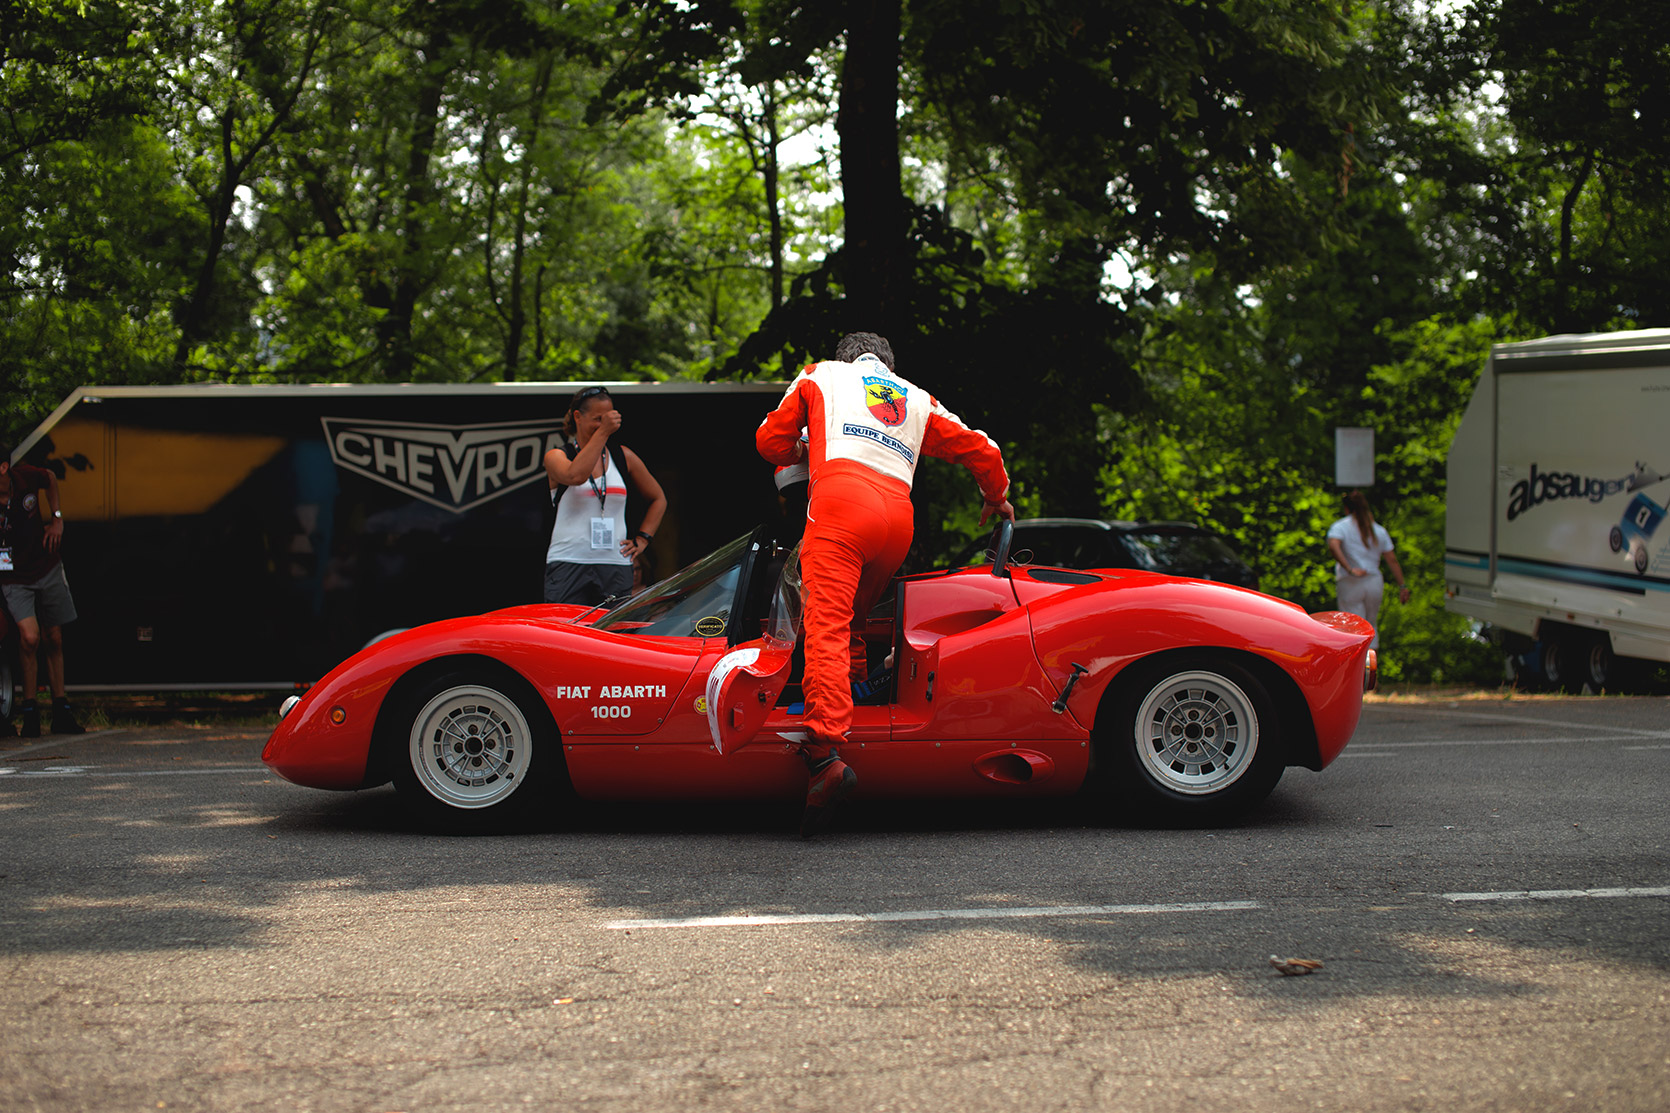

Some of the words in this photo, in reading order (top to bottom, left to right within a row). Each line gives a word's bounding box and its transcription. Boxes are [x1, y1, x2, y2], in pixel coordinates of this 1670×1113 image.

[845, 426, 880, 439] EQUIPE
[557, 686, 591, 698] FIAT
[600, 685, 666, 698] ABARTH
[591, 705, 631, 718] 1000
